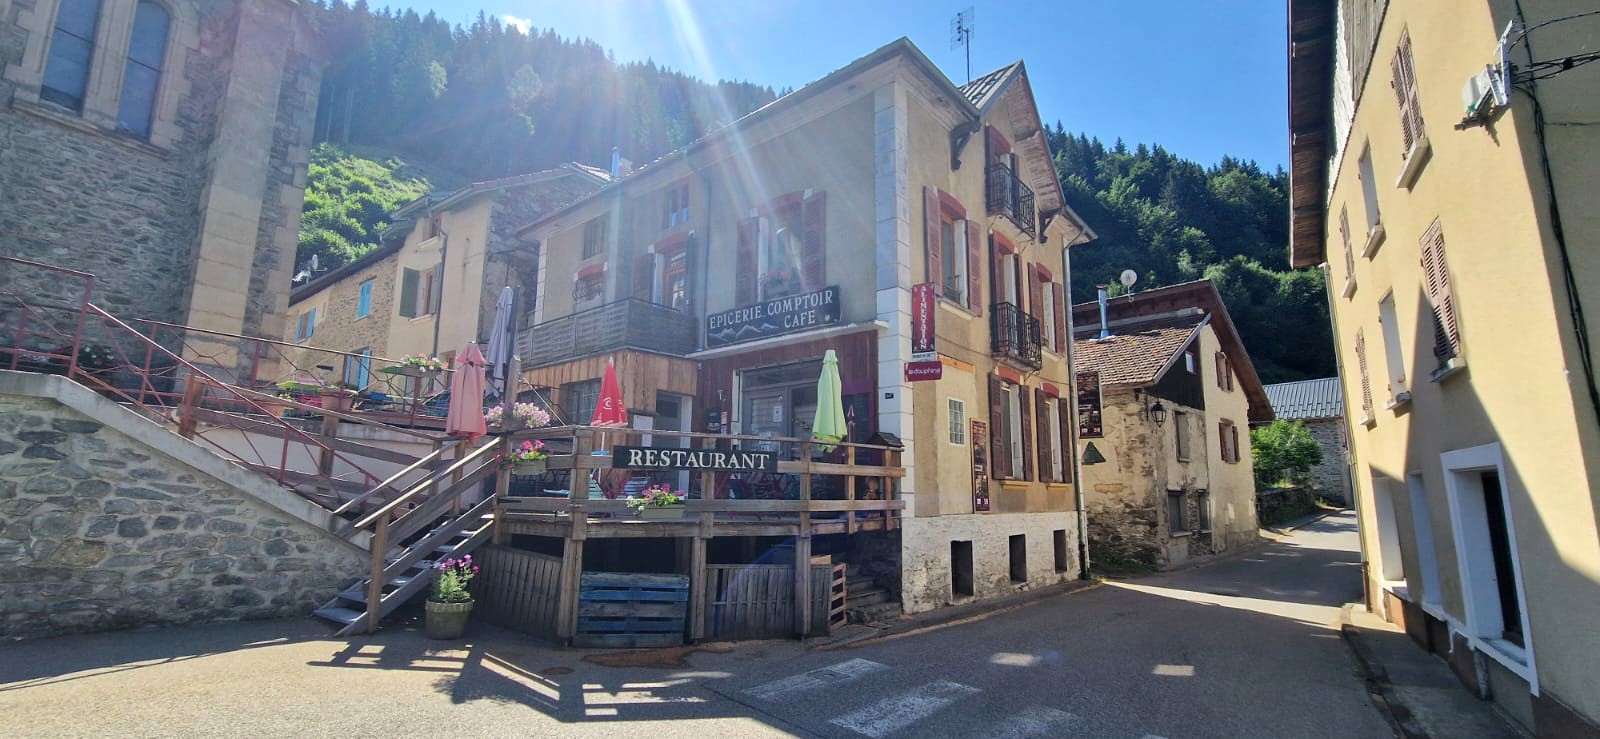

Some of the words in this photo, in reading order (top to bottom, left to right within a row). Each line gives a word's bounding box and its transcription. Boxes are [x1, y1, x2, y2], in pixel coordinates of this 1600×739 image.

[710, 305, 762, 329] EPICERIE
[767, 290, 833, 316] COMPTOIR
[784, 310, 815, 328] CAFE
[628, 449, 769, 470] RESTAURANT
